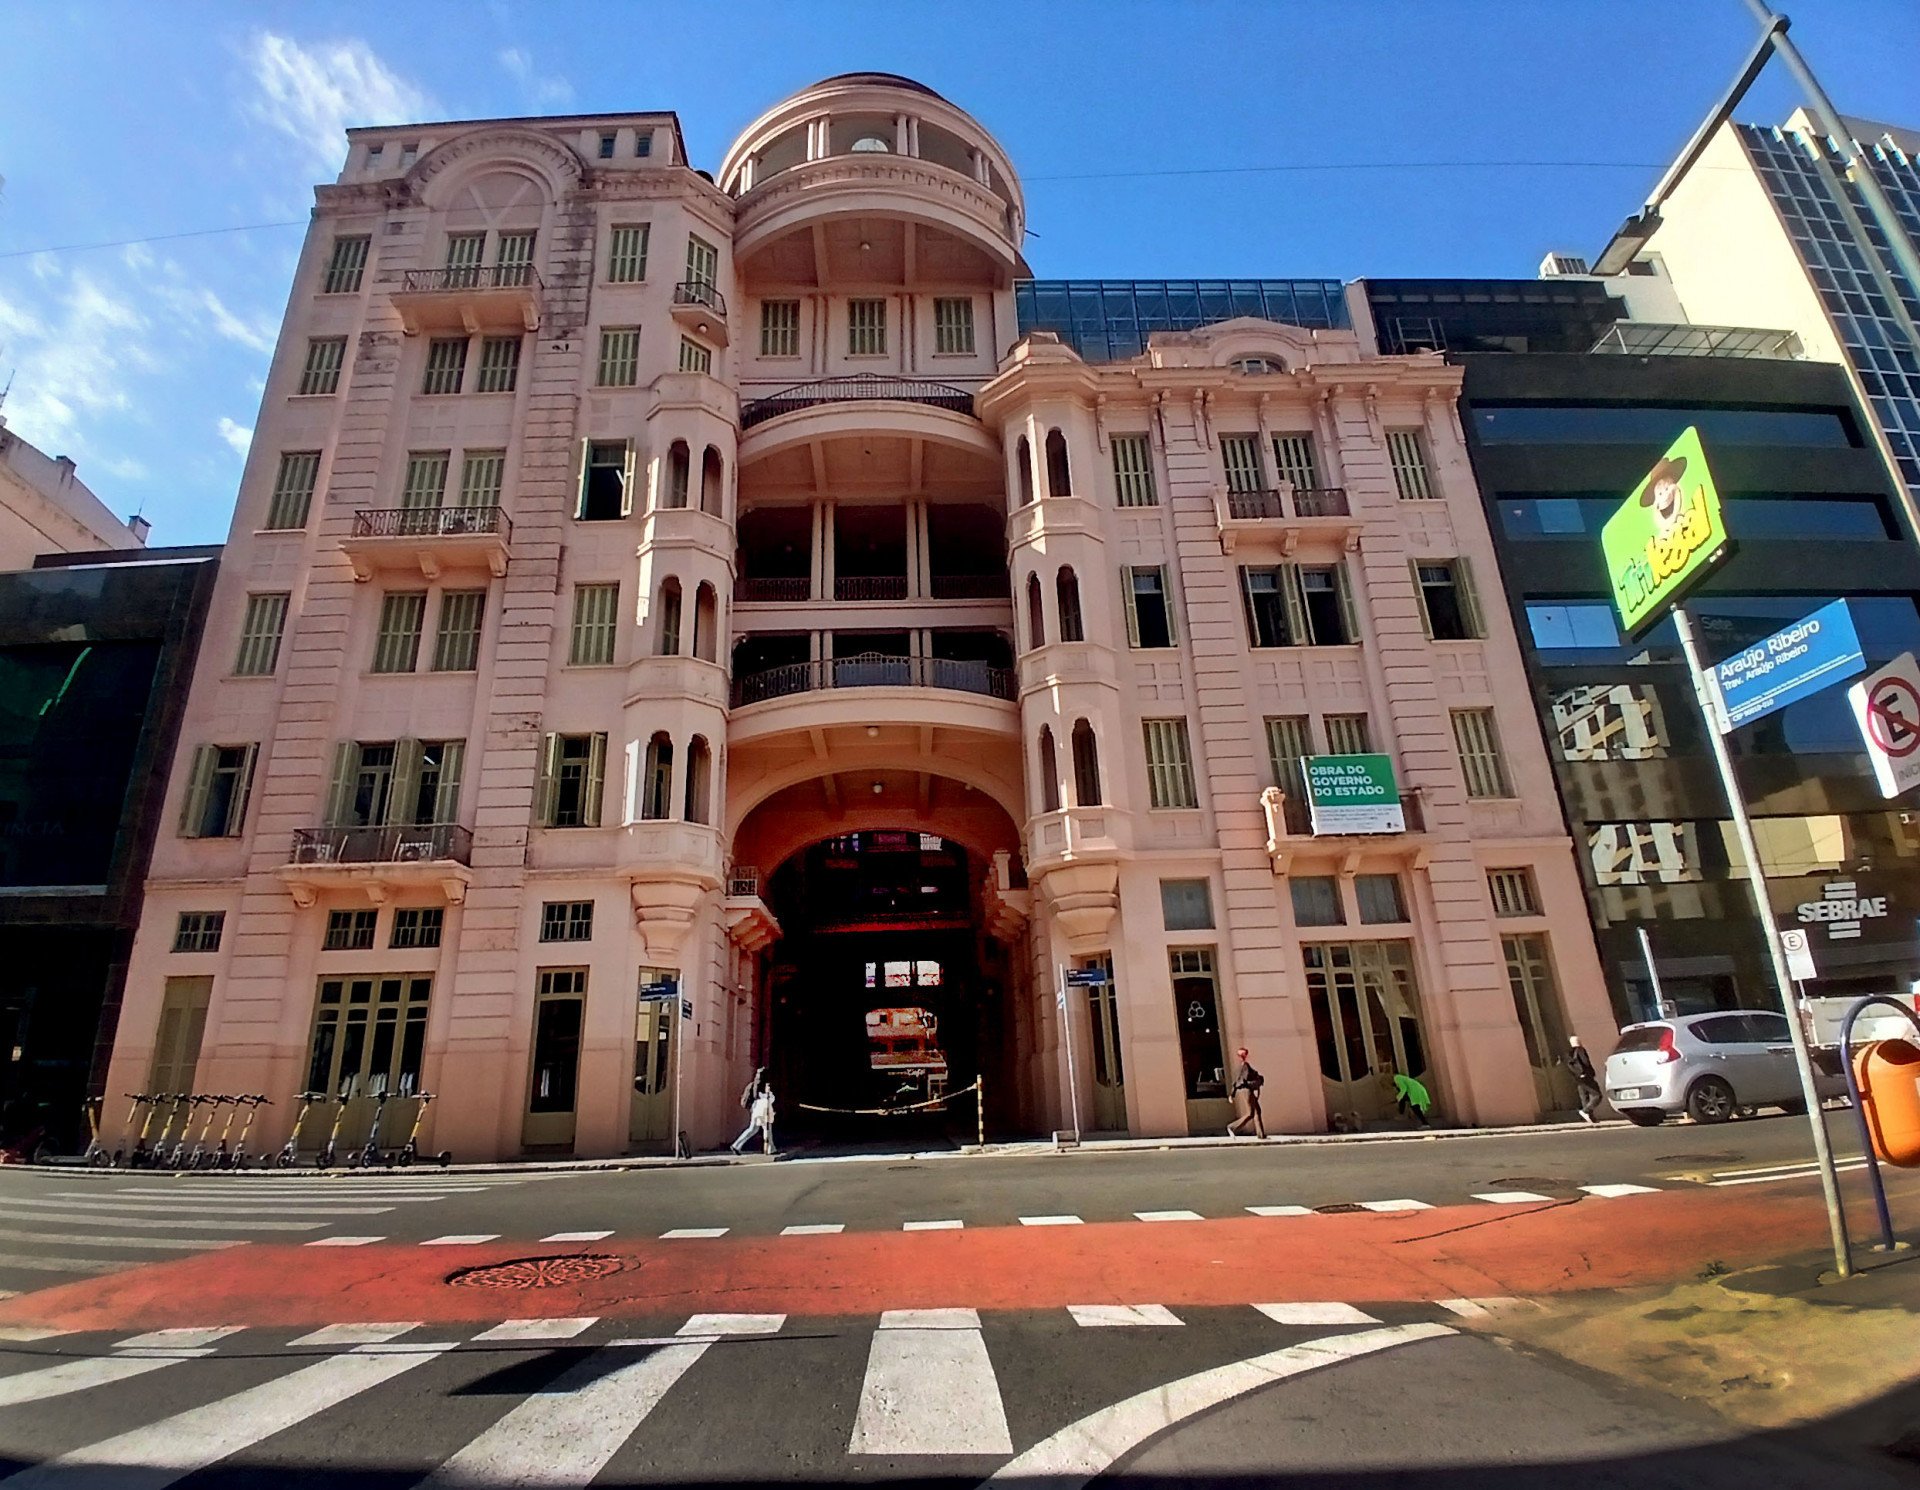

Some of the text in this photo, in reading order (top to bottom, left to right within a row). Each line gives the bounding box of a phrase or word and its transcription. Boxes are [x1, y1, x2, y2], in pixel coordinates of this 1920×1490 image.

[1720, 620, 1820, 680] Araújo Ribeiro
[1722, 643, 1808, 691] Trav. Araújo Ribeiro
[1309, 765, 1365, 776] OBRA DO
[1311, 776, 1373, 786] GOVERNO
[1313, 786, 1385, 797] DO ESTADO
[1797, 897, 1888, 923] SEBRAE
